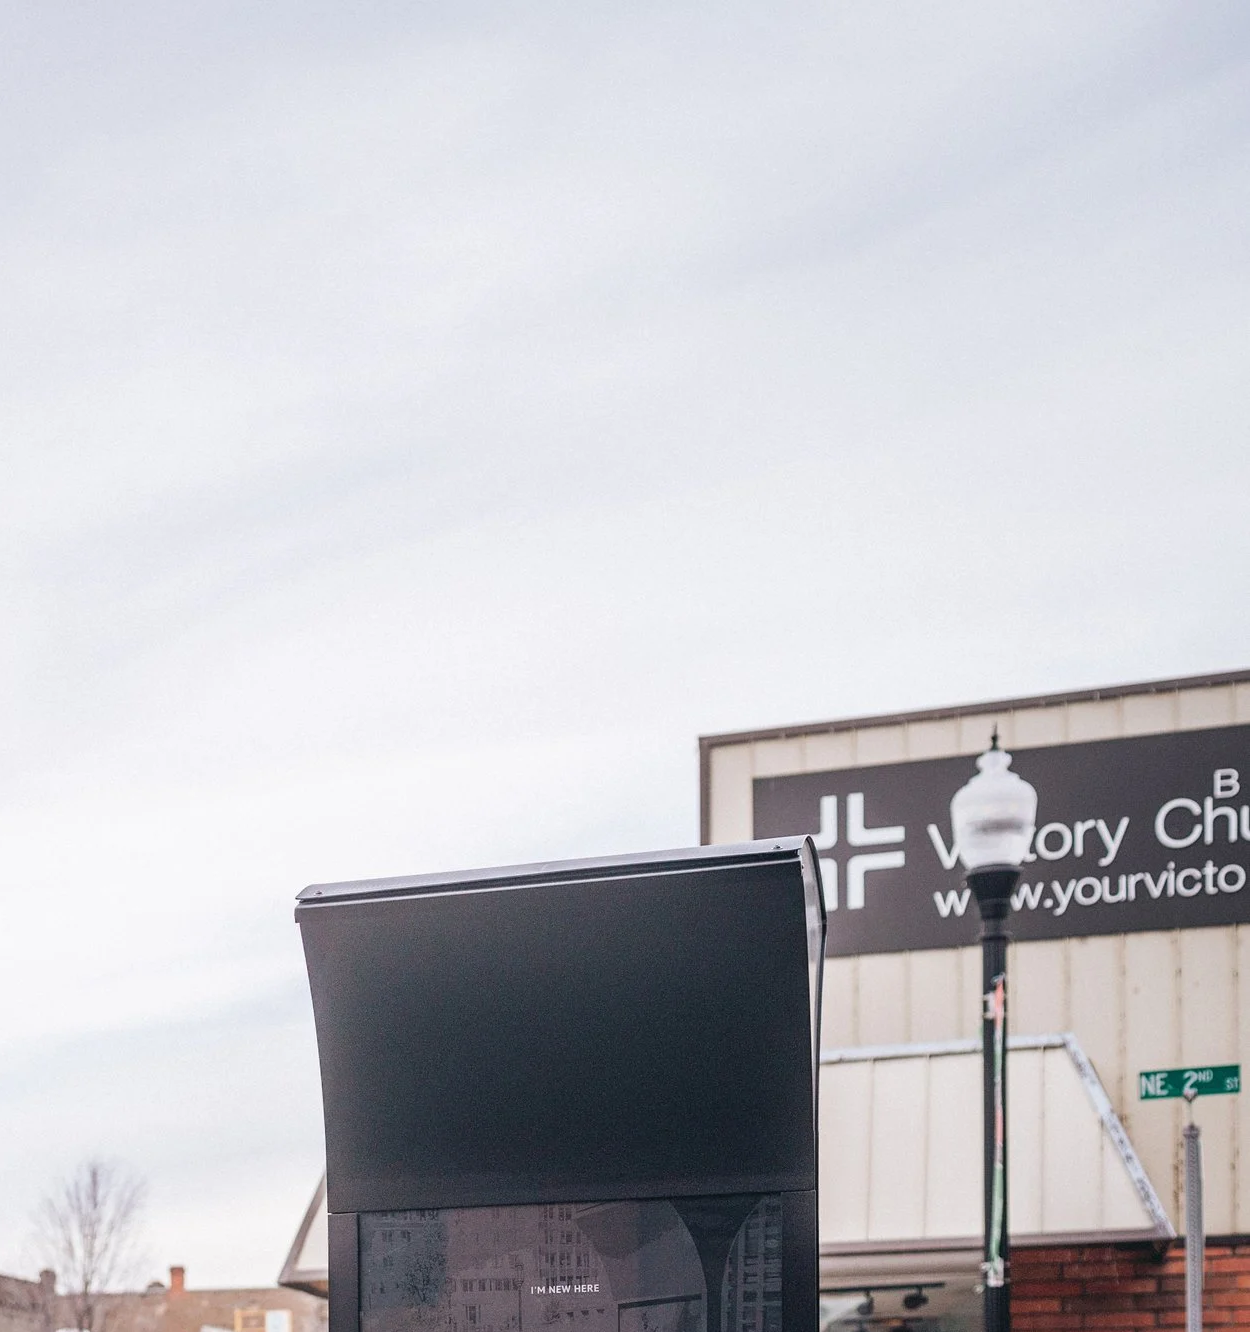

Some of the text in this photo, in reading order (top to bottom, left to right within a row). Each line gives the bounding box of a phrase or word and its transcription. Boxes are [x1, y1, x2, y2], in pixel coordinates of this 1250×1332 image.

[1213, 768, 1240, 799] B
[927, 816, 1130, 870] Vory
[933, 860, 1246, 918] ww.yourvicto
[1140, 1072, 1169, 1097] NE
[1182, 1069, 1214, 1094] 2ND
[530, 1284, 600, 1295] I'M NEW HERE
